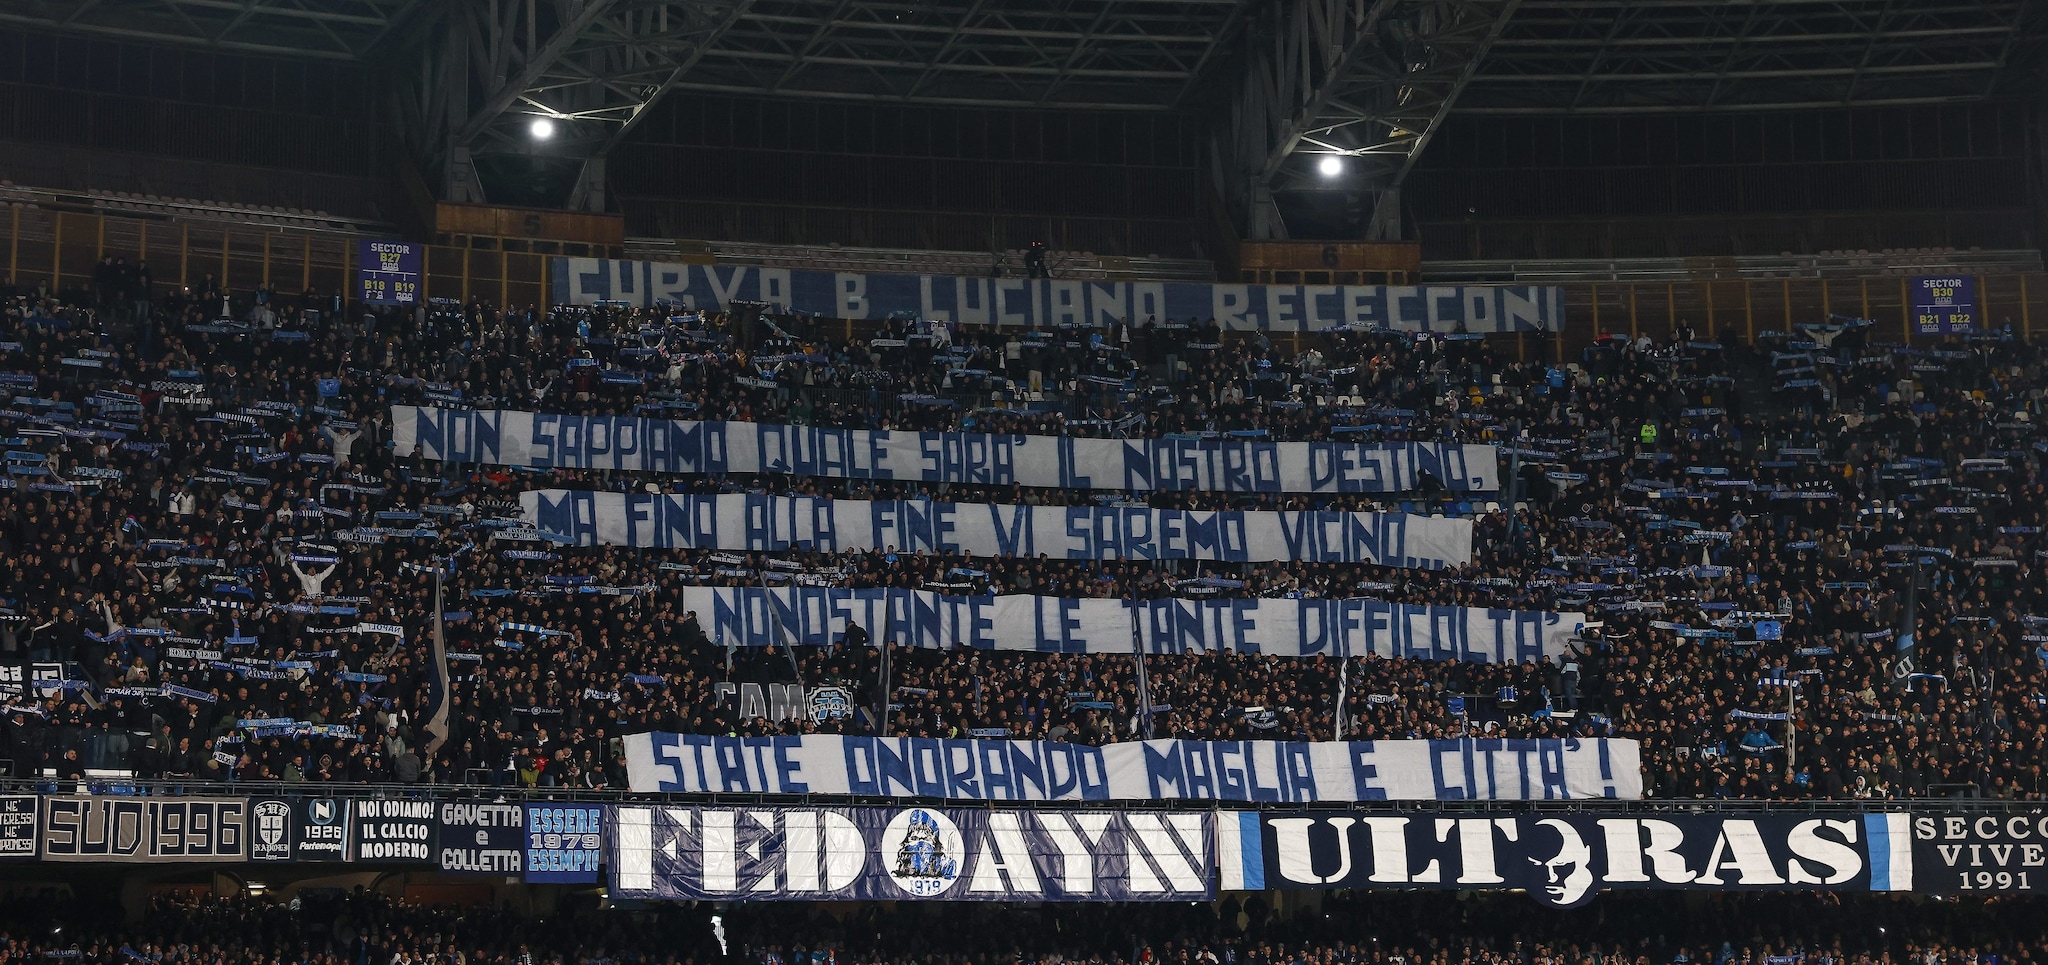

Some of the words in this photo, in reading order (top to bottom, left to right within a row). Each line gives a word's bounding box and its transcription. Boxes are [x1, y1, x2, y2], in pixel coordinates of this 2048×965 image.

[524, 216, 541, 235] 5
[370, 243, 410, 254] SECTOR
[380, 252, 401, 263] B27
[1322, 247, 1339, 266] 6
[364, 280, 385, 290] B18
[395, 281, 416, 292] B19
[1923, 279, 1962, 288] SECTOR
[1932, 288, 1954, 297] B30
[568, 257, 792, 315] CURVA
[835, 273, 869, 320] B
[919, 275, 1165, 329] LUCIANO
[1212, 285, 1558, 332] RECECCONI
[1920, 314, 1939, 324] B21
[1949, 313, 1971, 324] B22
[416, 407, 502, 465] NON
[531, 412, 728, 474] SAPPIAMO
[757, 423, 893, 479] QUALE
[919, 430, 1027, 485] SARA'
[1057, 435, 1091, 489] IL
[1123, 438, 1281, 492] NOSTRO
[1308, 440, 1484, 493] DESTINO,
[538, 489, 598, 547] MA
[625, 493, 718, 551] FINO
[745, 494, 835, 552] ALLA
[871, 499, 960, 557] FINE
[988, 502, 1033, 559] VI
[1066, 507, 1248, 563] SAREMO
[1278, 510, 1444, 571] VICINO...
[713, 586, 995, 652] NONOSTANTE
[1035, 594, 1088, 654] LE
[1121, 598, 1261, 658] TANTE
[1298, 598, 1560, 667] DIFFICOLTA'
[650, 729, 808, 793] STATE
[842, 734, 1110, 800] ONORANDO
[1141, 738, 1318, 801] MAGLIA
[1348, 738, 1388, 800] E
[1428, 737, 1582, 801] CITTA'
[358, 801, 380, 818] NOI
[383, 800, 434, 820] ODIAMO!
[441, 803, 522, 828] GAVETTA
[528, 807, 600, 833] ESSERE
[304, 825, 342, 839] 1926
[363, 823, 377, 840] IL
[381, 823, 429, 840] CALCIO
[475, 829, 489, 846] e
[531, 833, 601, 849] 1979
[361, 842, 429, 860] MODERNO
[441, 848, 522, 872] COLLETTA
[1936, 843, 2046, 867] VIVE
[1959, 871, 2032, 890] 1991
